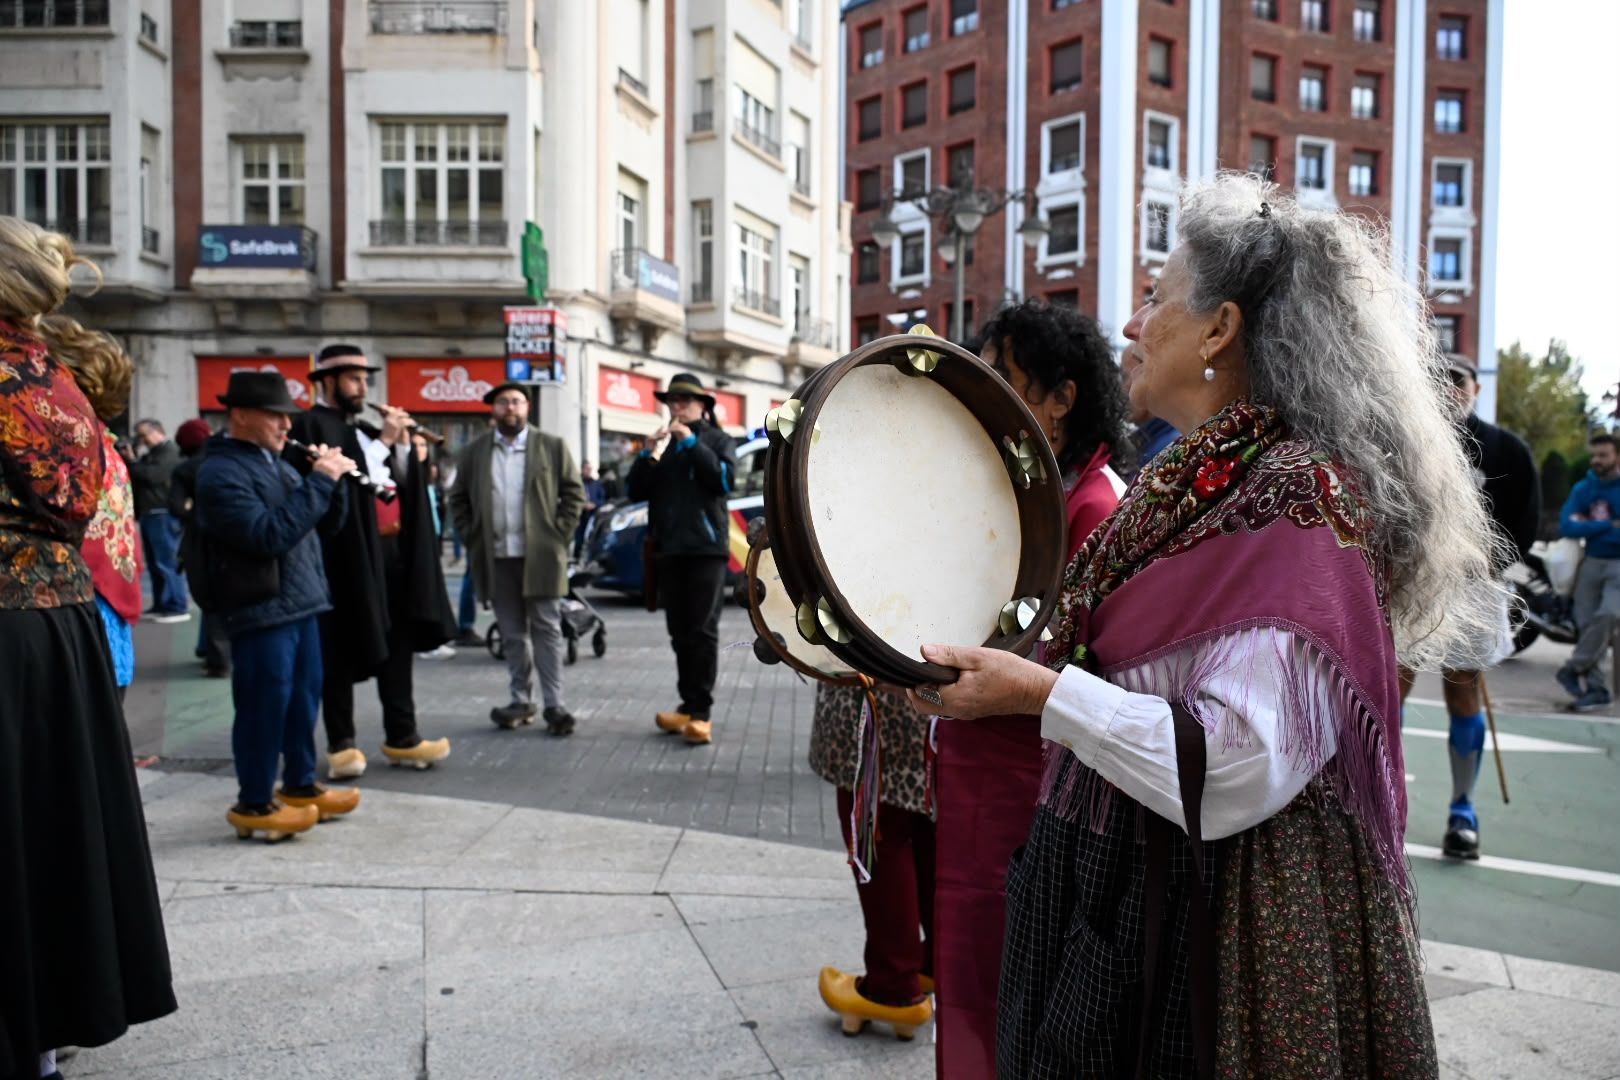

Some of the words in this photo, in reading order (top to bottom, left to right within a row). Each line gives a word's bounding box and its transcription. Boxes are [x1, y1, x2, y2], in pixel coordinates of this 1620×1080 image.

[230, 240, 298, 255] SafeBrok
[507, 338, 551, 354] TICKET
[511, 361, 525, 379] P
